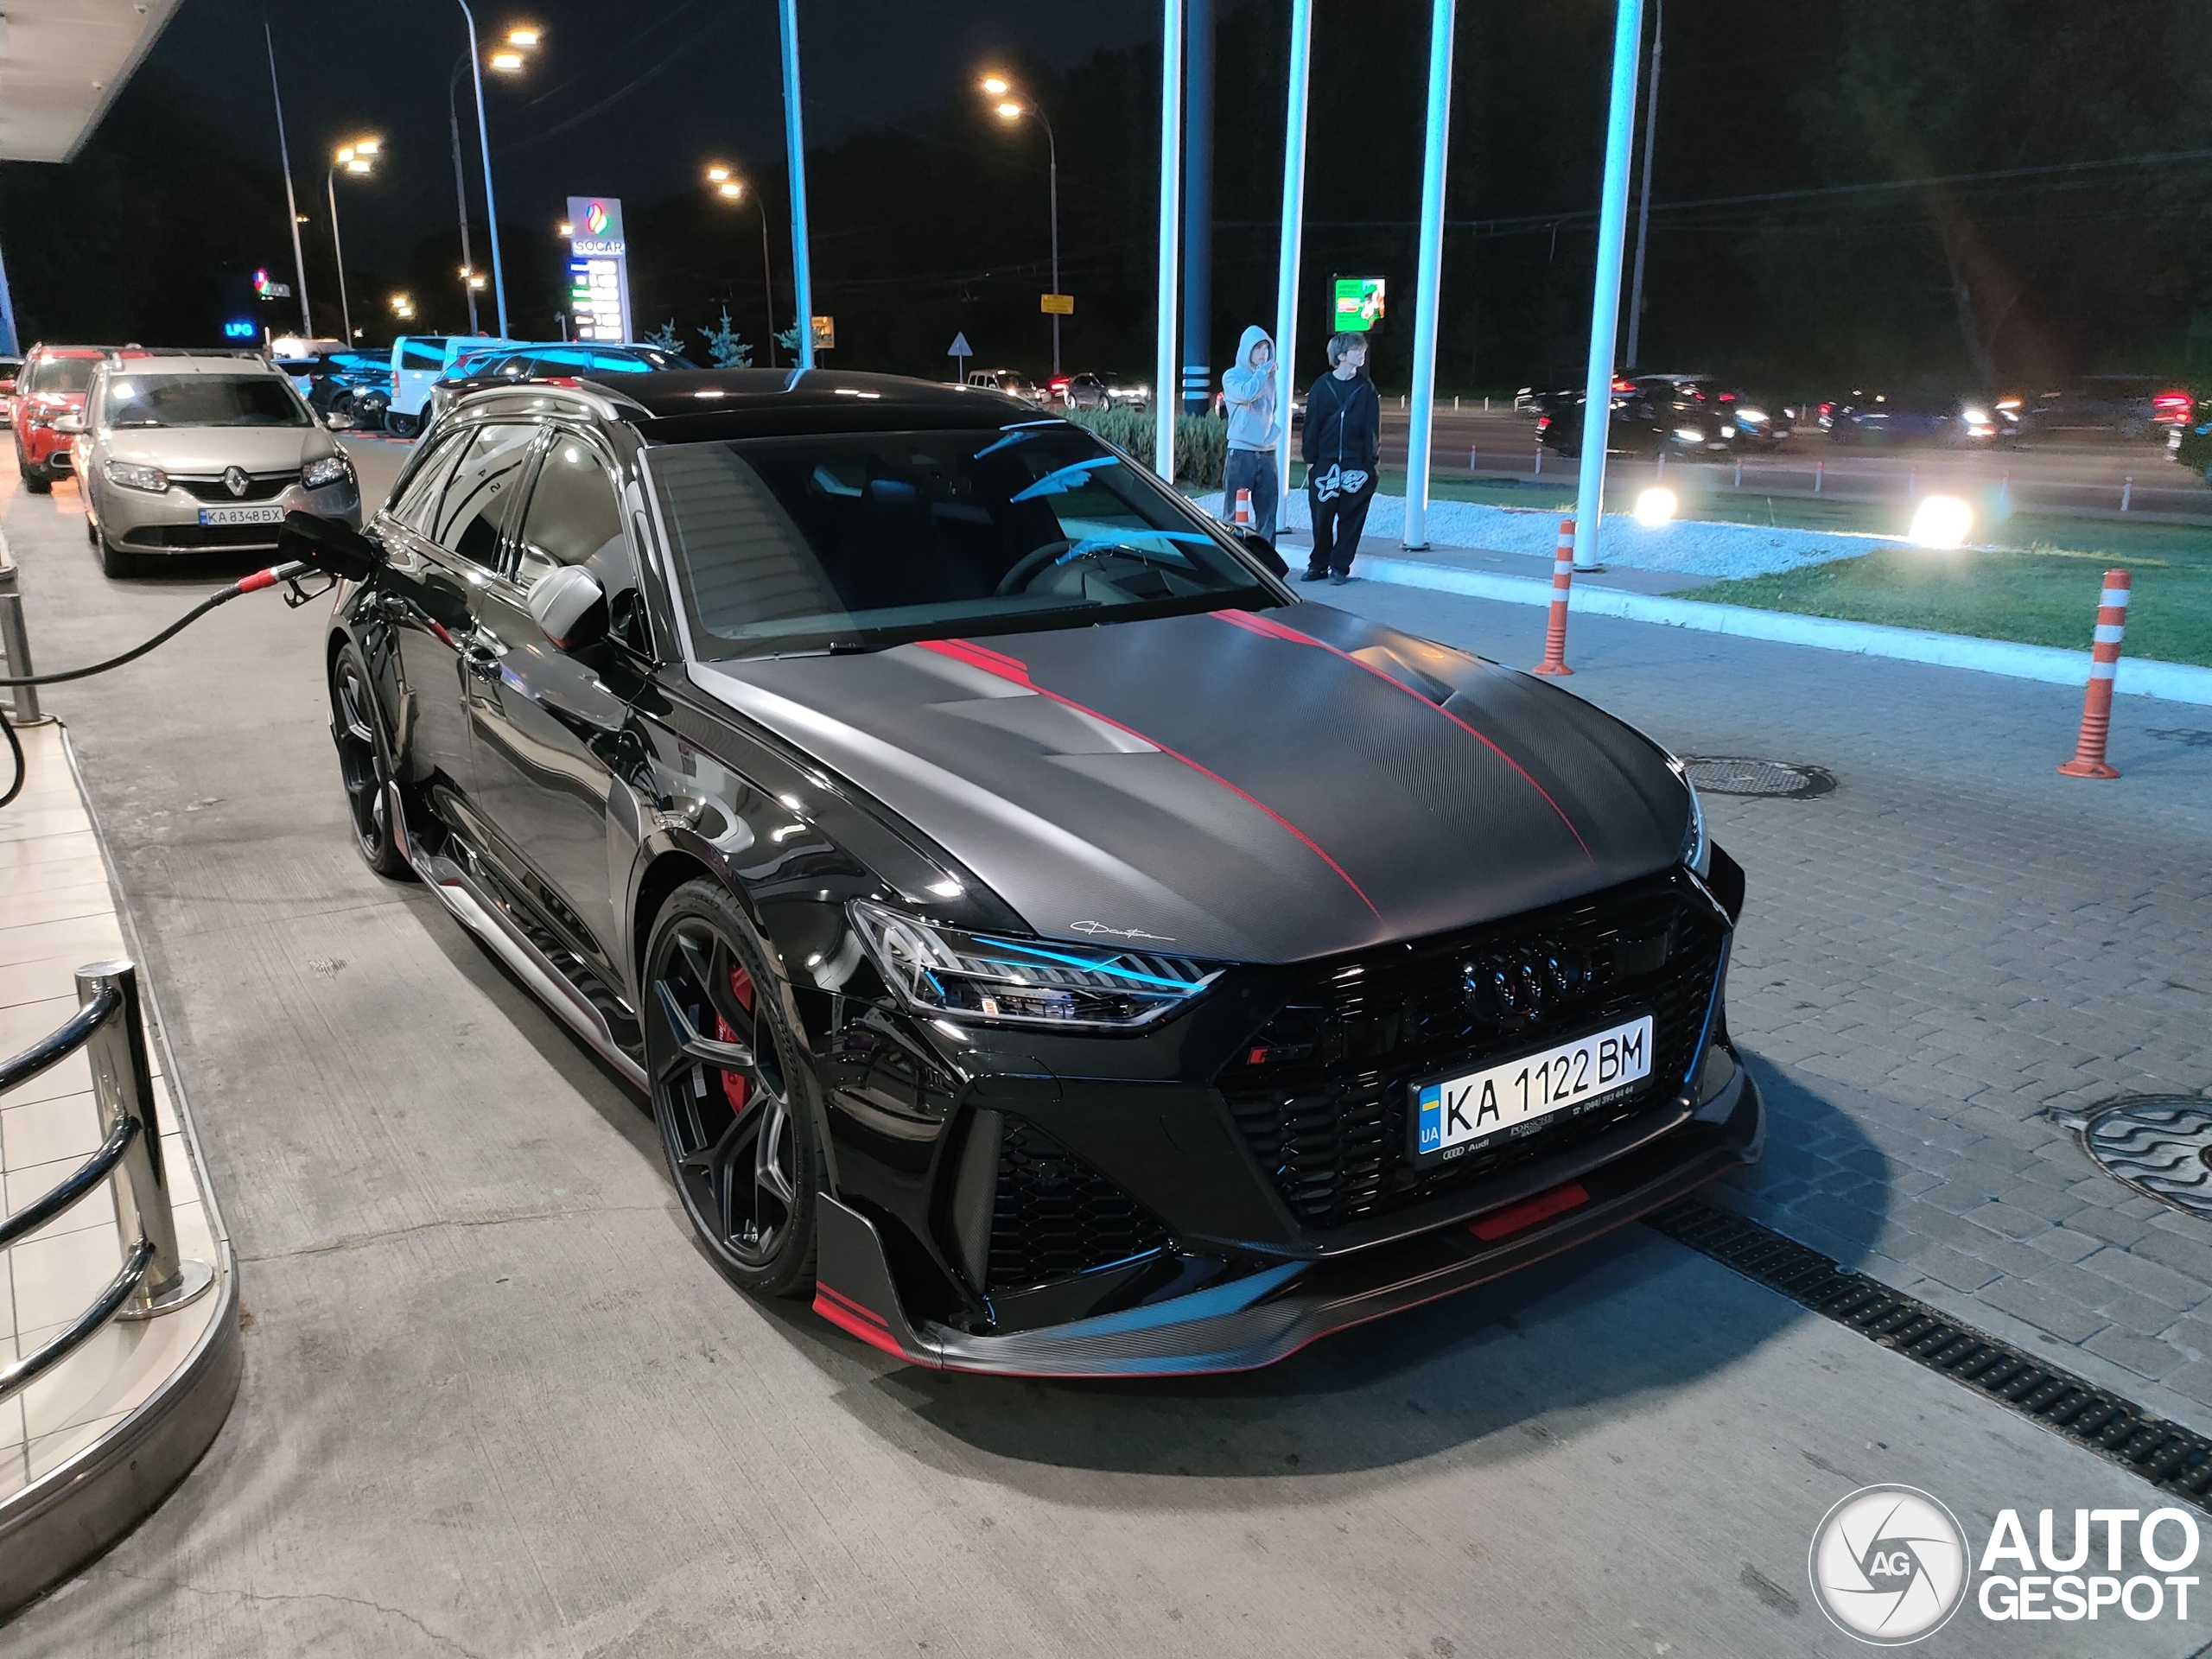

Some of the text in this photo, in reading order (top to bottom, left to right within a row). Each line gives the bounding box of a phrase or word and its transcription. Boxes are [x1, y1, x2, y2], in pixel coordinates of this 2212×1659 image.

[575, 241, 622, 252] SOCAR
[207, 510, 281, 523] KA 8348 BX
[1446, 1027, 1643, 1136] KA 1122 BM
[1421, 1127, 1440, 1143] UA
[1468, 1138, 1489, 1152] Audi
